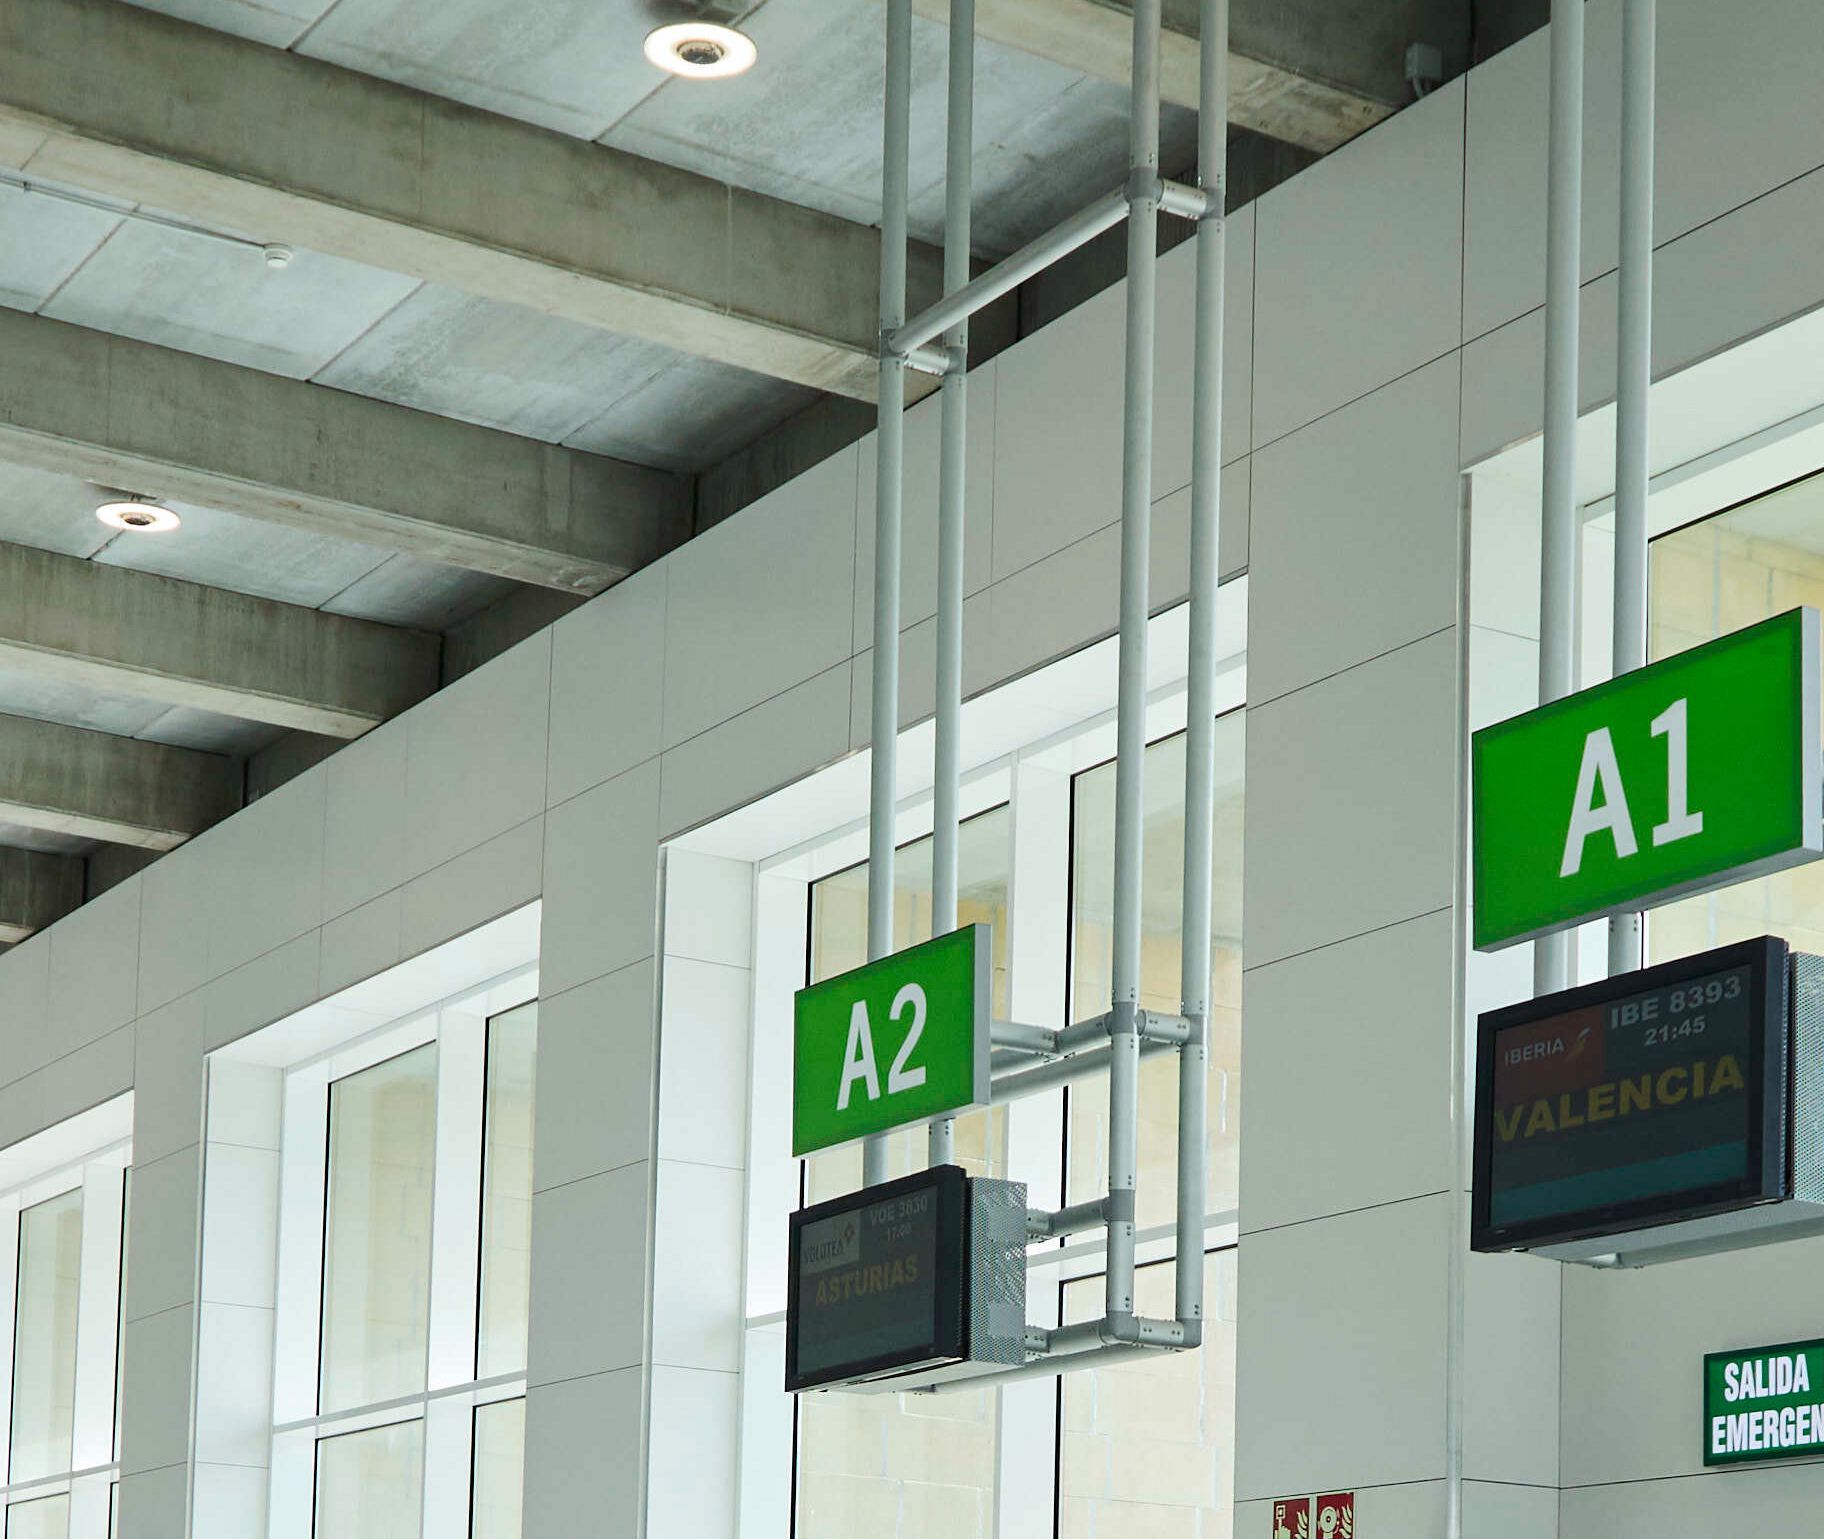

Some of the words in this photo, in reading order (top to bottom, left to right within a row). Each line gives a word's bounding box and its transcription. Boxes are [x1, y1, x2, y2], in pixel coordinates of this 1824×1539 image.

[1559, 697, 1704, 878] A1
[1610, 998, 1659, 1029] IBE
[1669, 976, 1742, 1013] 8393
[836, 982, 928, 1111] A2
[1504, 1037, 1565, 1066] IBERIA
[1644, 1016, 1706, 1046] 21:45
[1494, 1054, 1745, 1142] VALENCIA
[816, 1257, 918, 1306] ASTURIAS
[1725, 1354, 1810, 1402] SALIDA
